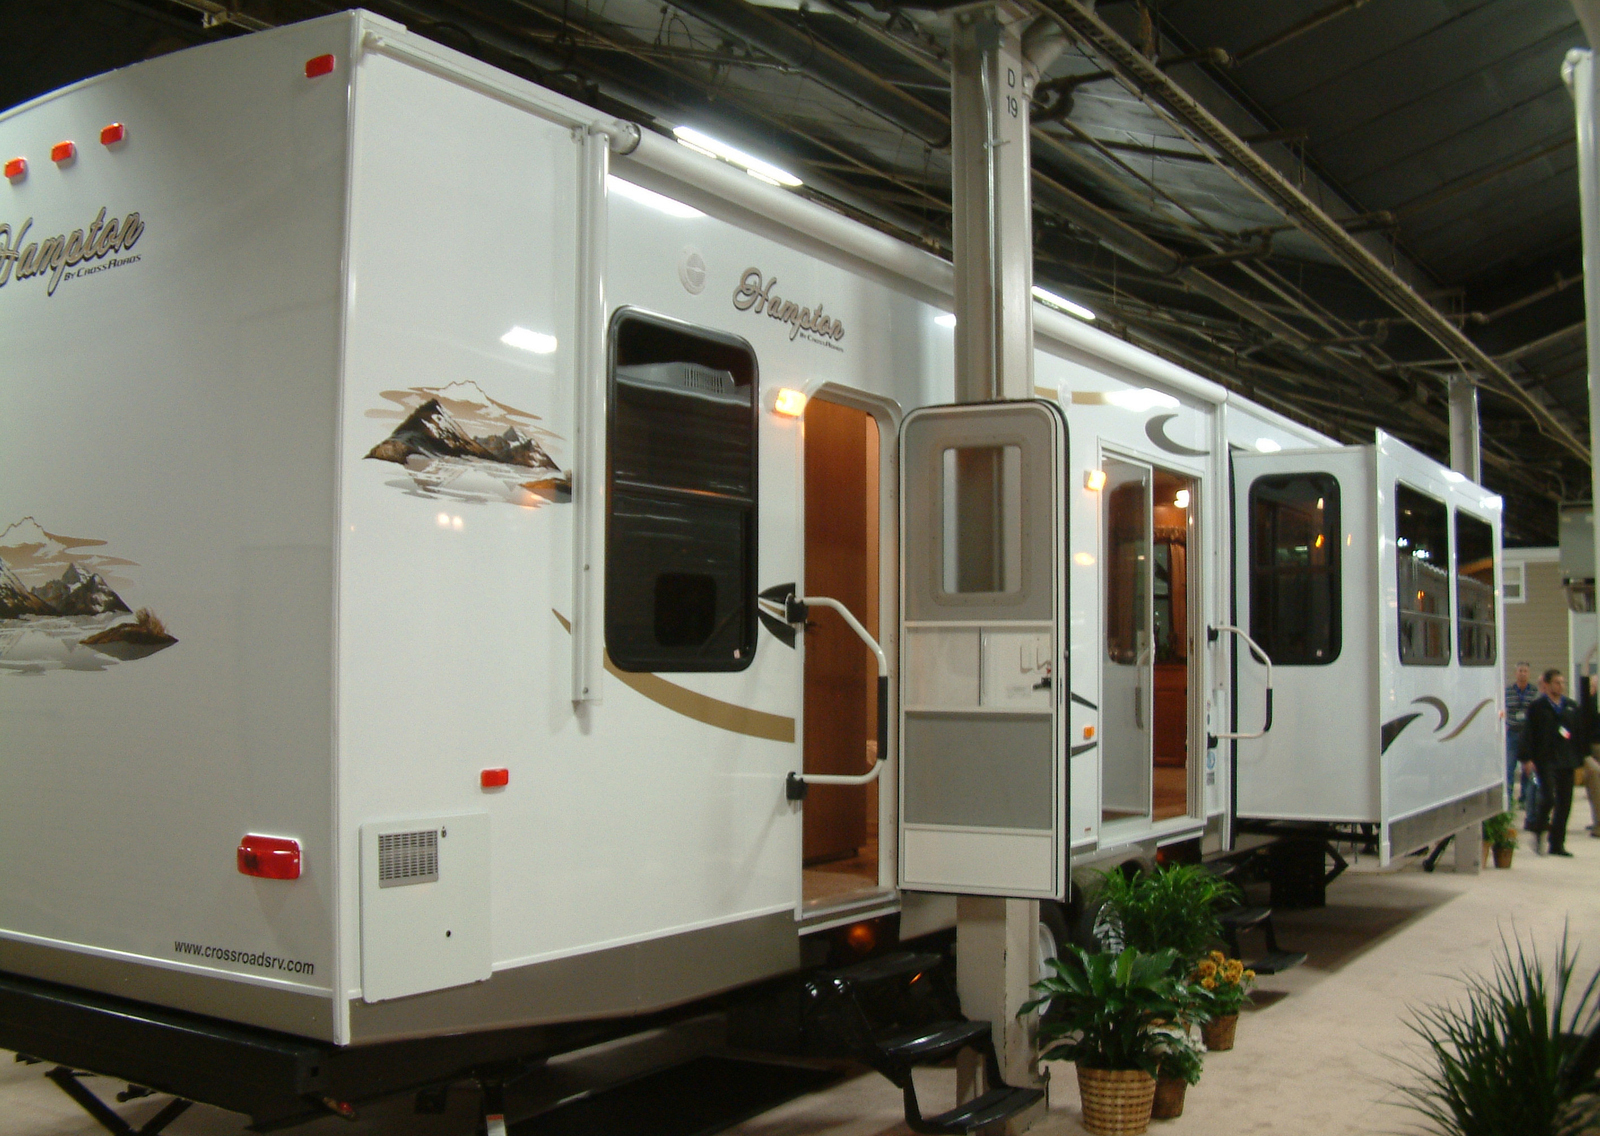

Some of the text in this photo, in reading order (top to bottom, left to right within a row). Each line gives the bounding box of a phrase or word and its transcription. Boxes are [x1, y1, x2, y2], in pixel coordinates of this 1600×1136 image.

[1007, 67, 1016, 89] D
[1006, 95, 1018, 118] 19
[732, 266, 845, 342] Hampton
[174, 940, 315, 975] www.crossroadsrv.com
